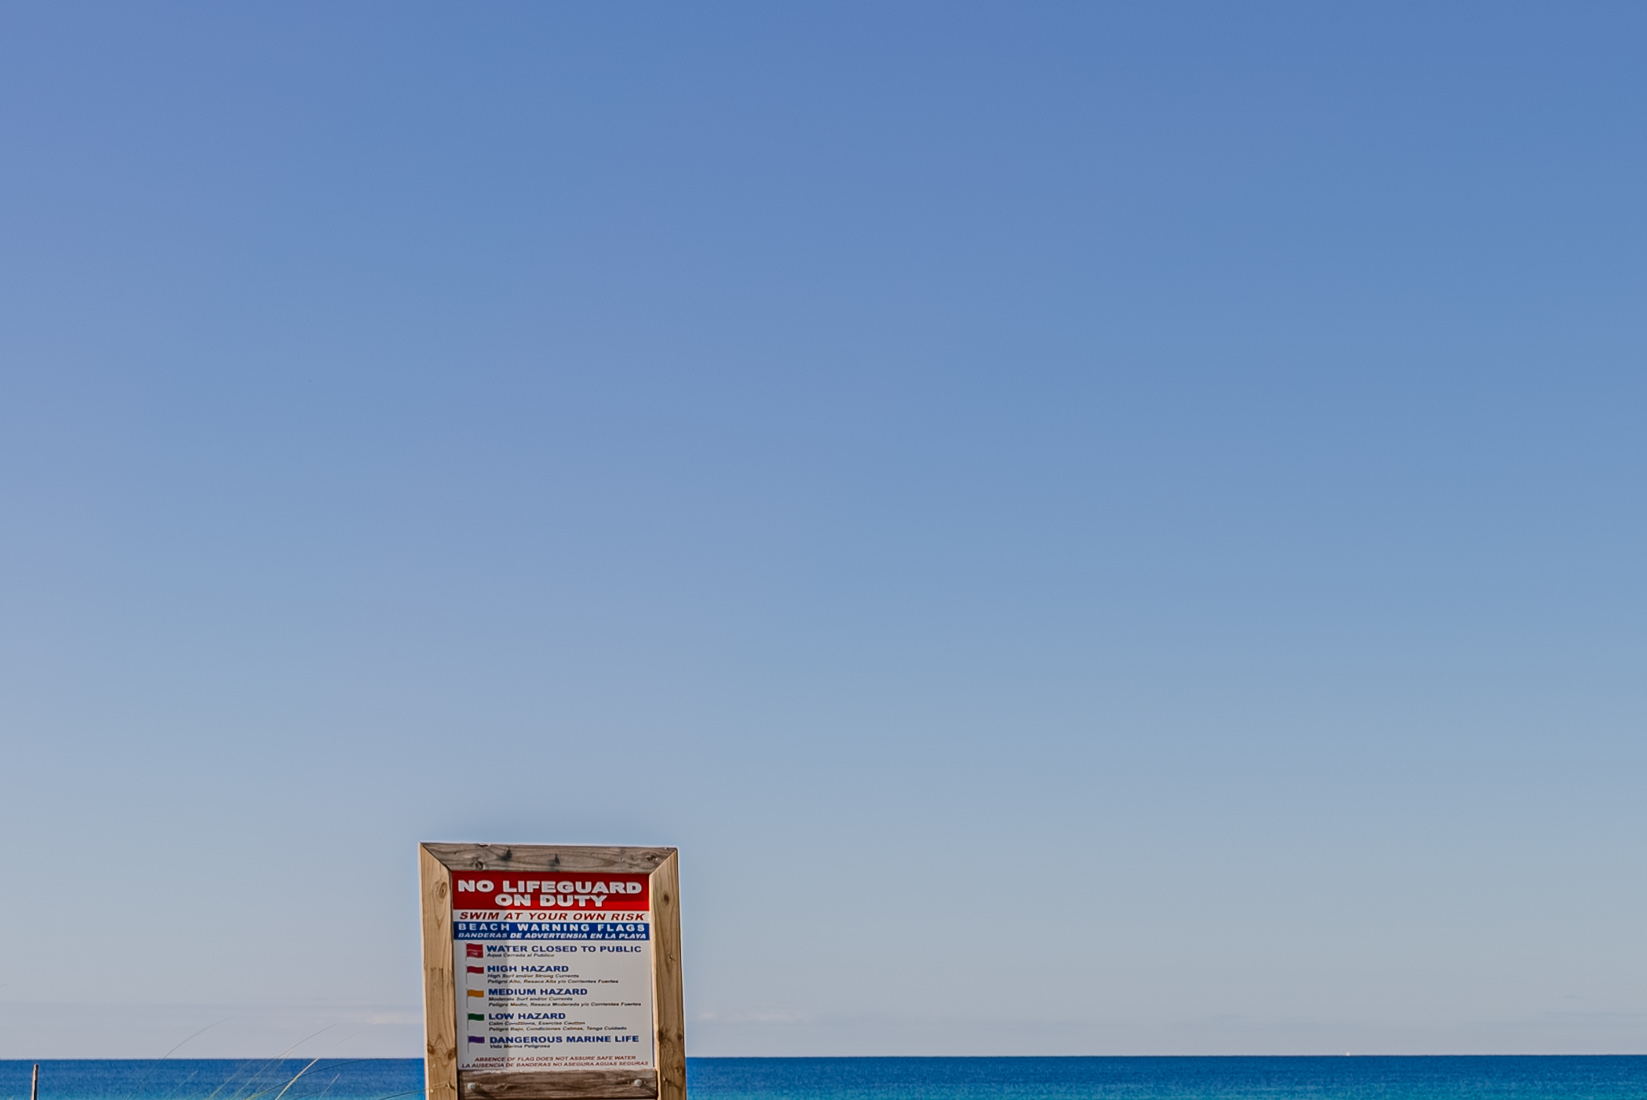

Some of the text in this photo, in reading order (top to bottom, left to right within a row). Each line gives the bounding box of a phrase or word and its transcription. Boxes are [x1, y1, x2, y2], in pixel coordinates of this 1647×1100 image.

[458, 880, 642, 894] NO LIFEGUARD
[495, 894, 607, 907] ON DUTY
[459, 912, 500, 920] SWIM
[504, 912, 522, 920] AT
[529, 912, 568, 921] YOUR
[573, 913, 606, 921] OWN
